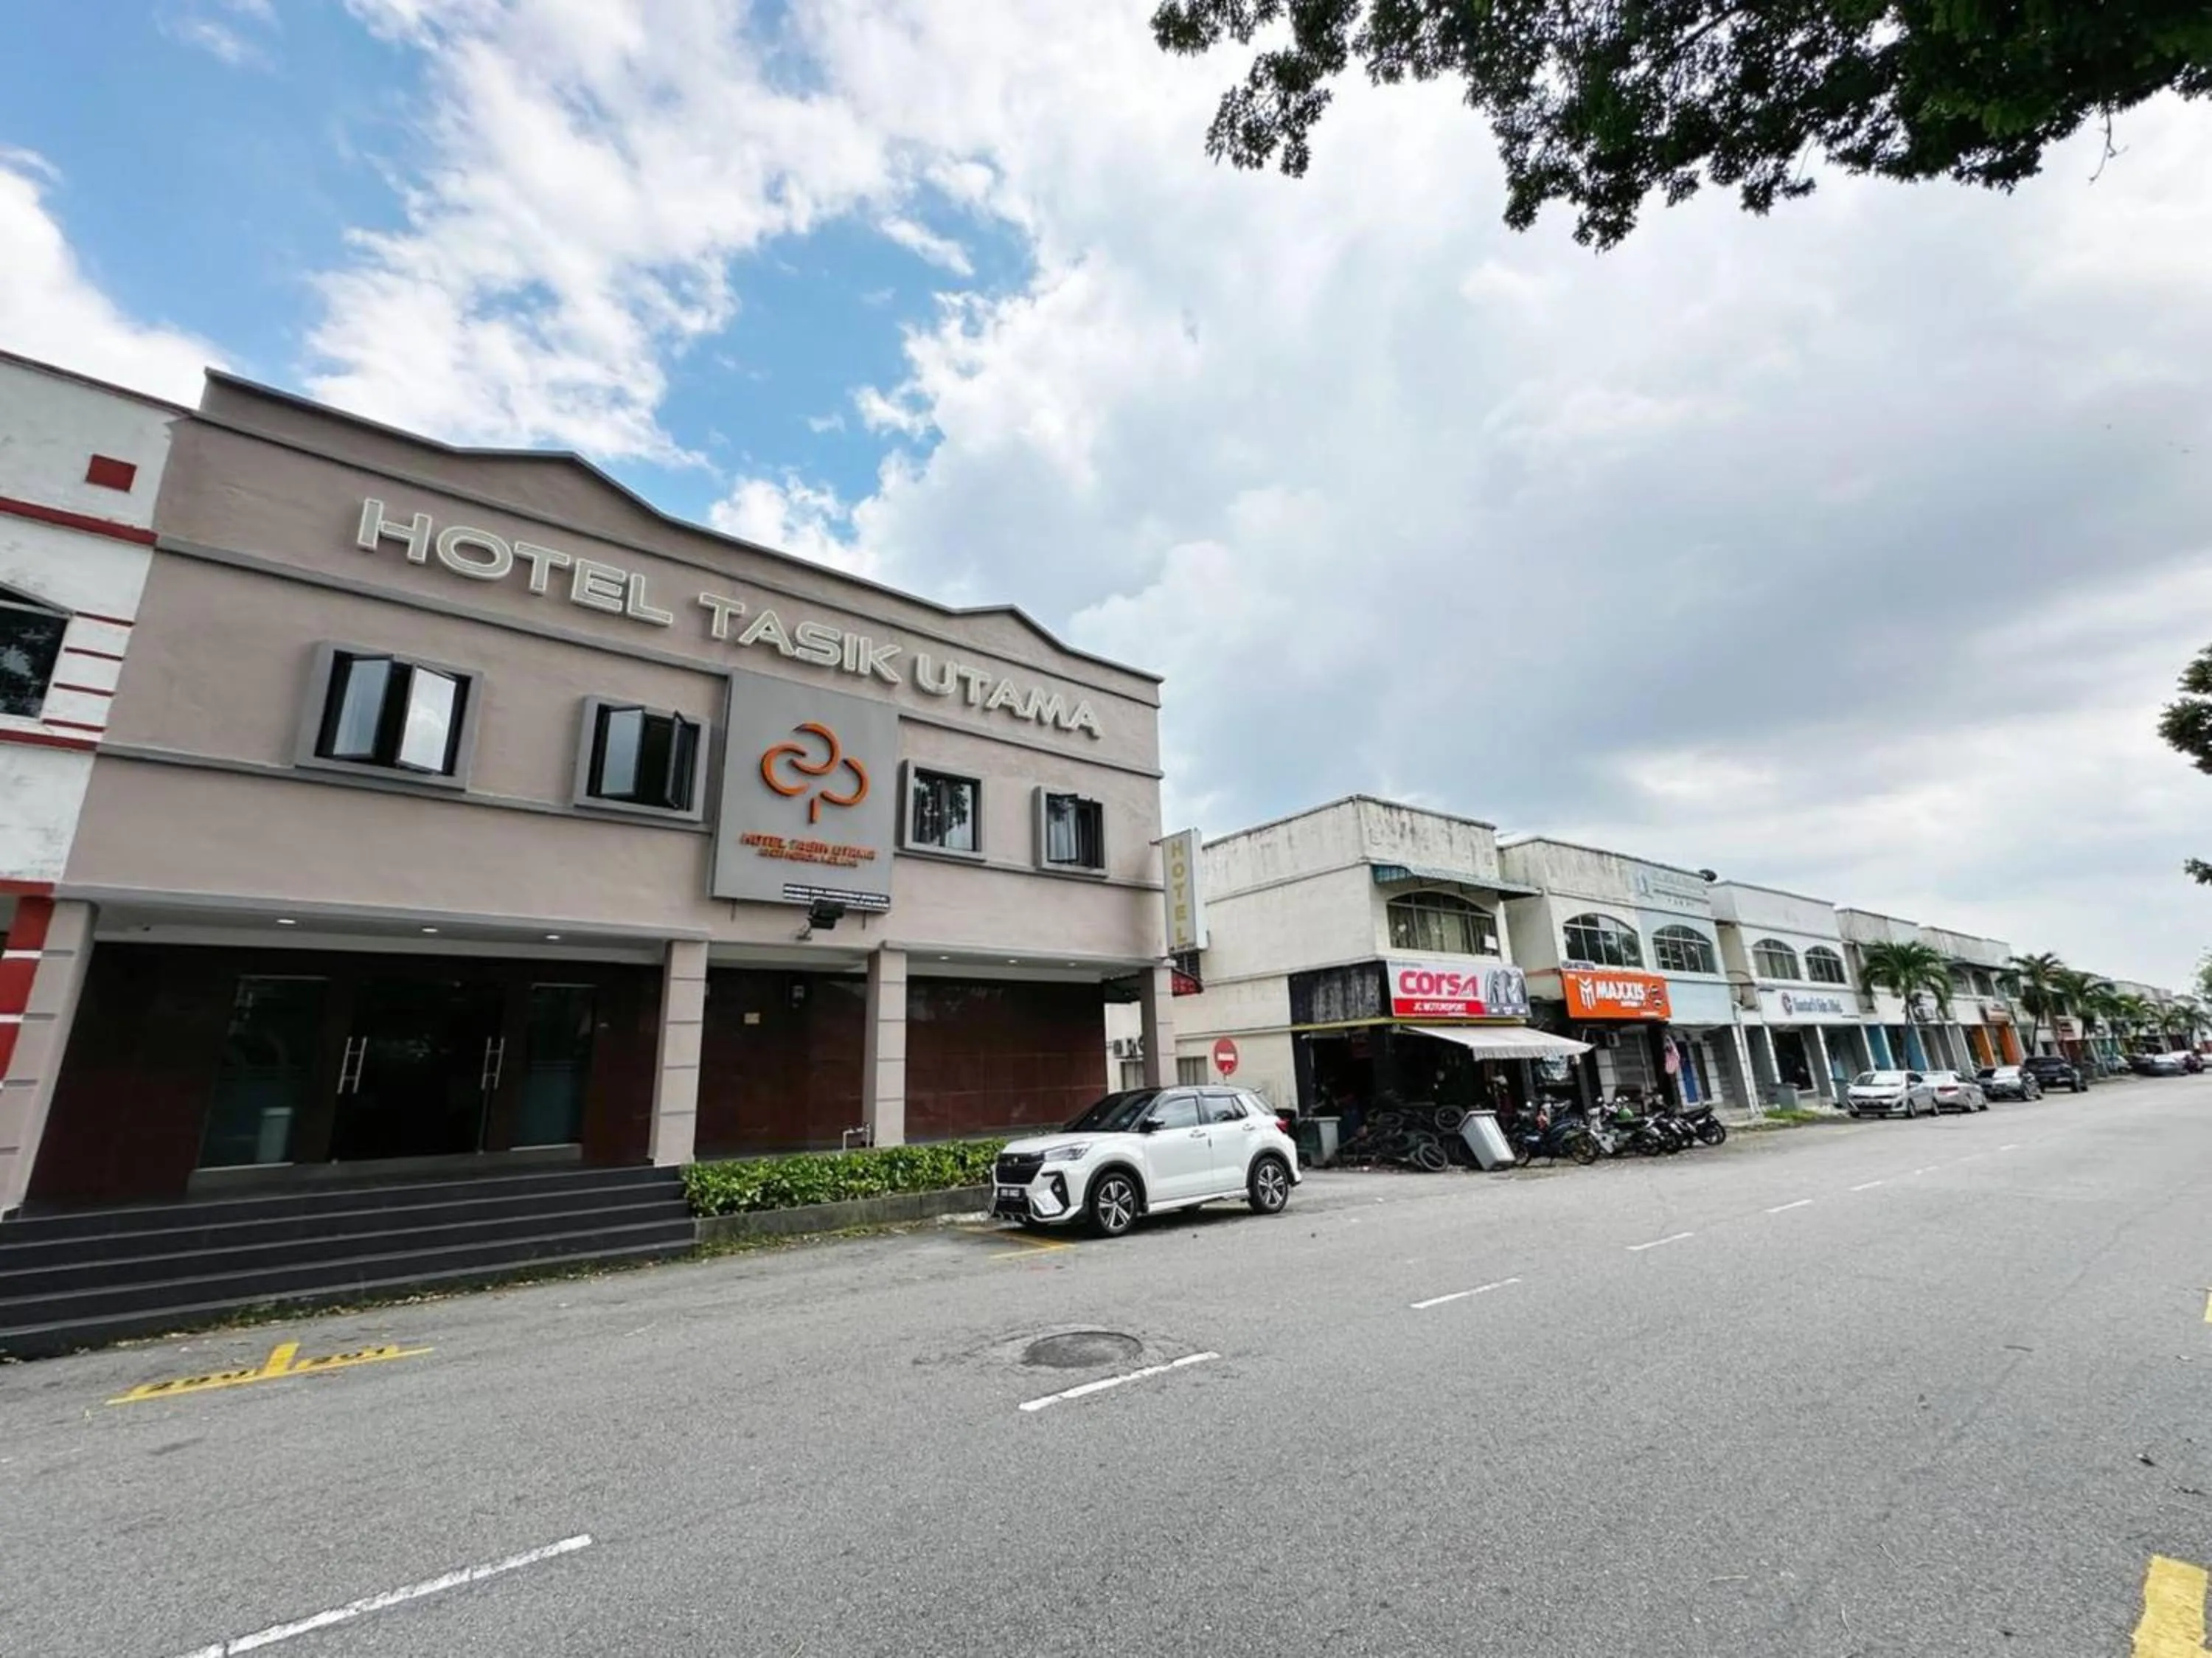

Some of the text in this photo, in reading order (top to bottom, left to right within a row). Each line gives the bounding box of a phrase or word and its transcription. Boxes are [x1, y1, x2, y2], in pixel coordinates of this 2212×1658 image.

[356, 496, 1102, 738] HOTEL TASIK UTAMA
[1172, 841, 1186, 941] HOTEL
[1596, 980, 1646, 1001] MAXXIS
